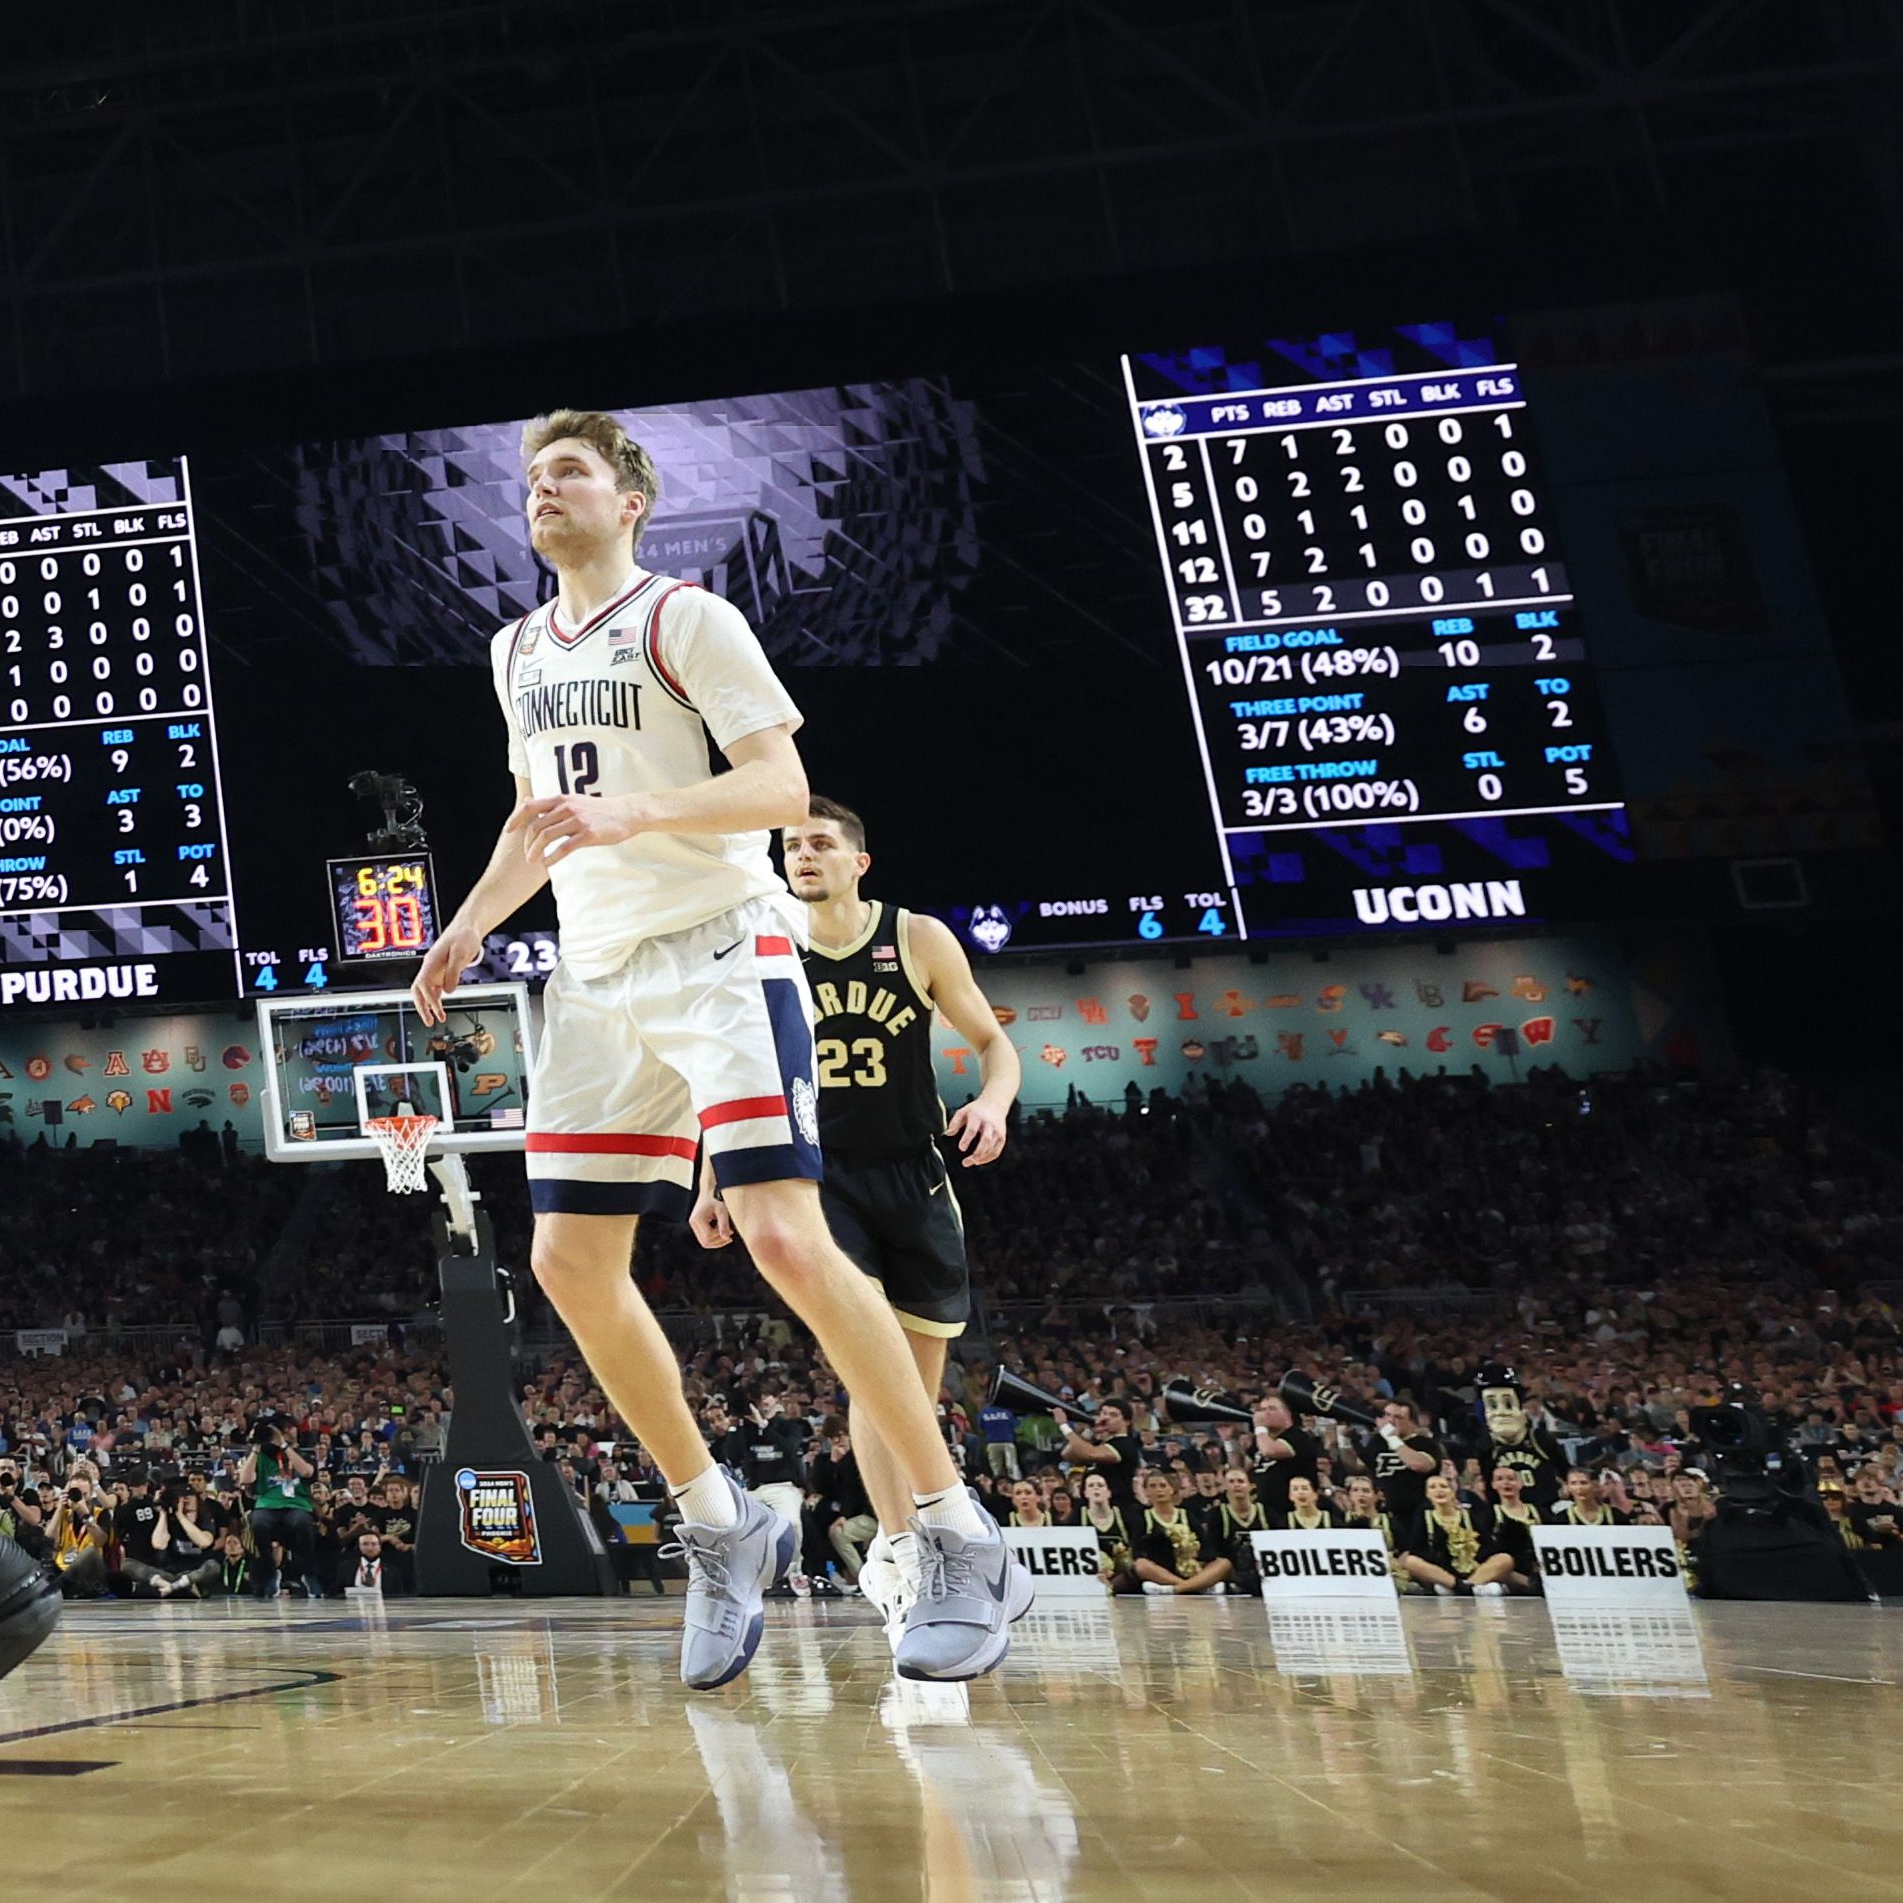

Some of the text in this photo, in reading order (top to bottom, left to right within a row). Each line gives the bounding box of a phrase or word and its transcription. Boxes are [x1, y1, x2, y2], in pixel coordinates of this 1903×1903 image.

[1211, 377, 1514, 424] PTS REB AST STL BLK FLS
[1163, 445, 1187, 470] 2
[1172, 482, 1193, 508] 5
[31, 526, 60, 542] AST
[73, 523, 102, 538] STL
[114, 518, 144, 534] BLK
[158, 513, 186, 529] FLS
[1172, 520, 1207, 545] 11
[664, 537, 727, 557] MEN'S
[1179, 557, 1218, 583] 12
[1185, 595, 1228, 622] 32
[1432, 611, 1559, 635] REB BLK
[6, 630, 21, 652] 2
[48, 626, 63, 648] 3
[1225, 628, 1343, 653] FIELD GOAL
[1439, 634, 1556, 667] 10 2
[9, 665, 20, 686] 1
[1206, 646, 1399, 685] 10/21 (48%)
[1447, 678, 1570, 702] AST TO
[1230, 692, 1364, 718] THREE POINT
[1464, 701, 1572, 733] 6 2
[102, 723, 201, 745] REB BLK
[1238, 713, 1394, 751] 3/7 (43%)
[112, 744, 195, 772] 9 2
[554, 741, 602, 797] 12
[1463, 745, 1592, 769] STL POT
[1245, 759, 1378, 784] FREE THROW
[1479, 768, 1587, 800] 0 5
[107, 784, 203, 804] AST TO
[1242, 779, 1419, 817] 3/3 (100%)
[118, 804, 201, 832] 3 3
[114, 844, 215, 864] STL POT
[125, 865, 209, 892] 1 4
[357, 865, 426, 897] 6:24
[1039, 892, 1227, 918] BONUS FLS TOL
[1353, 880, 1527, 925] UCONN
[352, 896, 423, 951] 30
[1137, 908, 1226, 940] 6 4
[246, 948, 328, 966] TOL FLS
[507, 941, 559, 973] 23
[1, 964, 159, 1004] PURDUE
[255, 963, 328, 992] 4 4
[814, 980, 917, 1037] RDUE
[817, 1038, 887, 1088] 23
[1081, 1045, 1120, 1062] TCU
[22, 1332, 65, 1345] SECTION
[356, 1328, 388, 1341] SECT
[469, 1489, 517, 1507] FINAL
[135, 1507, 154, 1522] 89
[472, 1508, 518, 1526] FOUR
[1262, 1548, 1387, 1578] BOILERS
[1542, 1546, 1677, 1578] BOILERS
